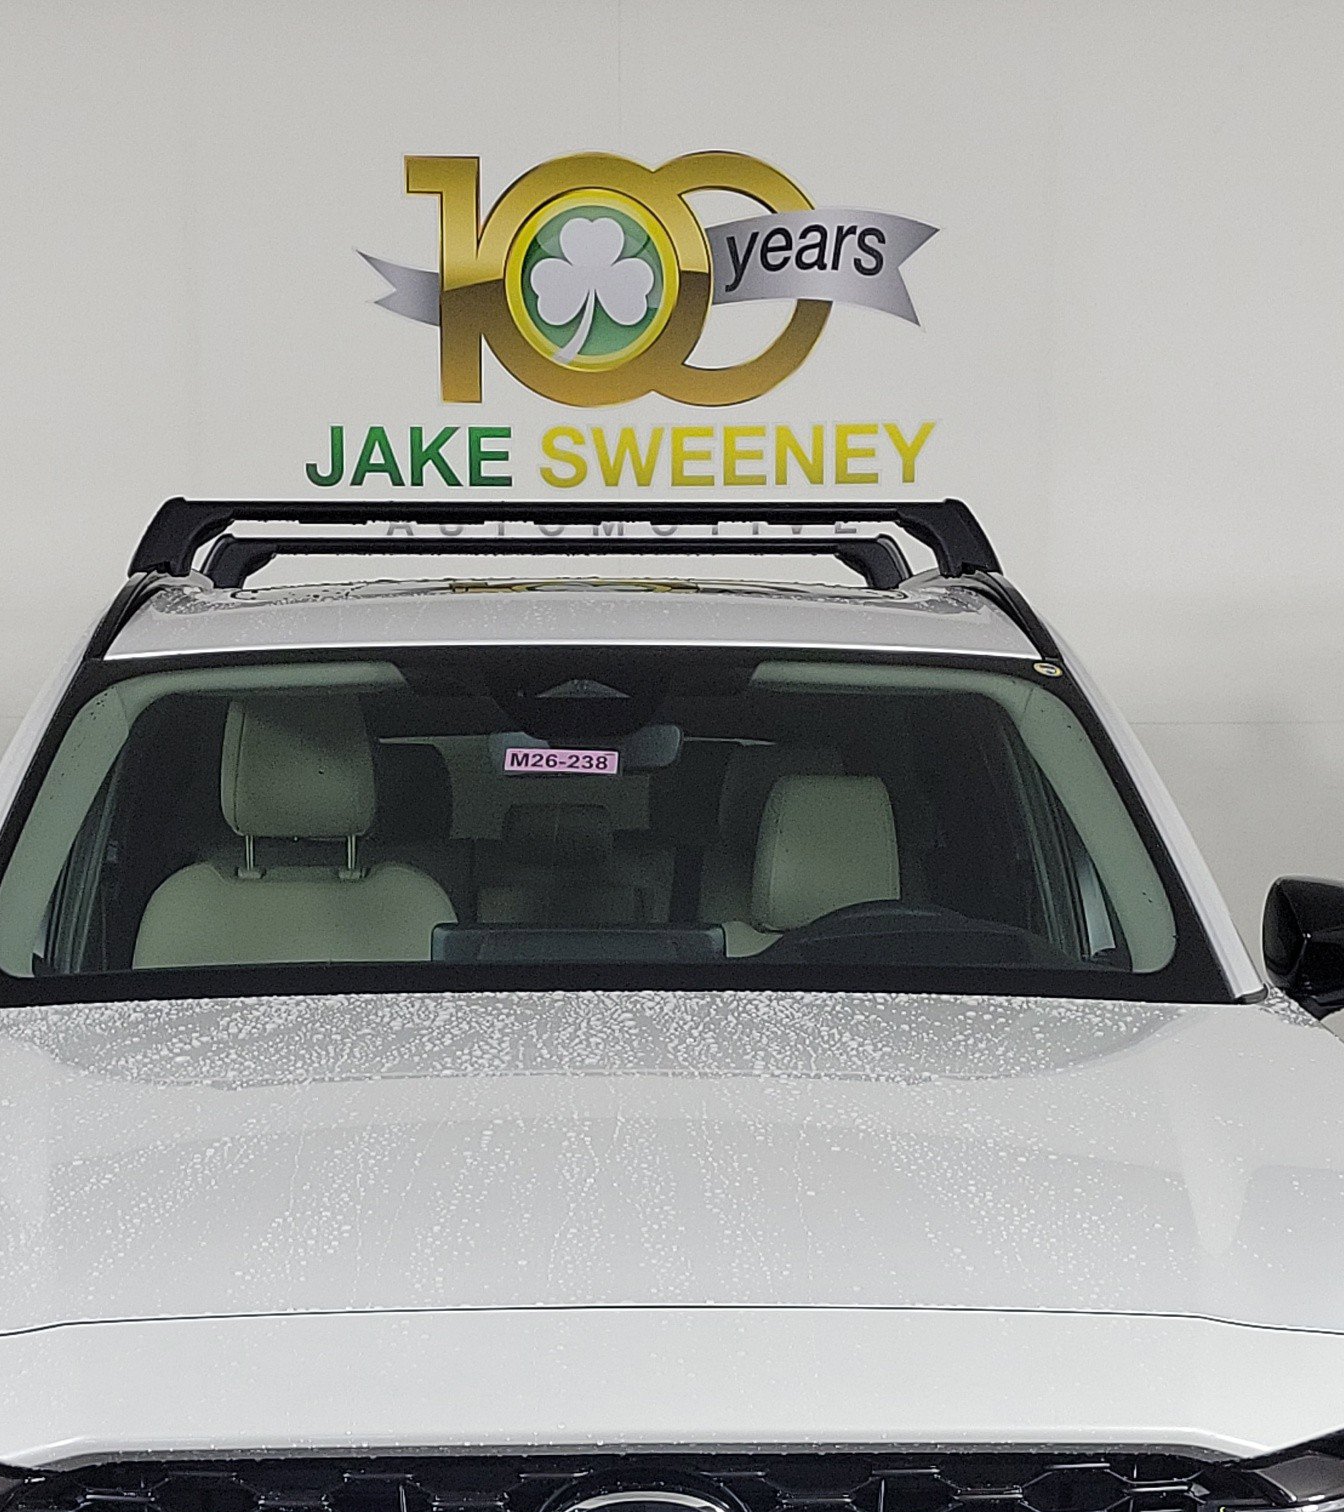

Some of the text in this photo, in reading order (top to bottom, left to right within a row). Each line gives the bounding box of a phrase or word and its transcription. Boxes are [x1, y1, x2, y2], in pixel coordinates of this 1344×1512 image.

[405, 150, 886, 407] 100 years
[305, 422, 937, 488] JAKE SWEENEY
[509, 752, 608, 770] M26-238
